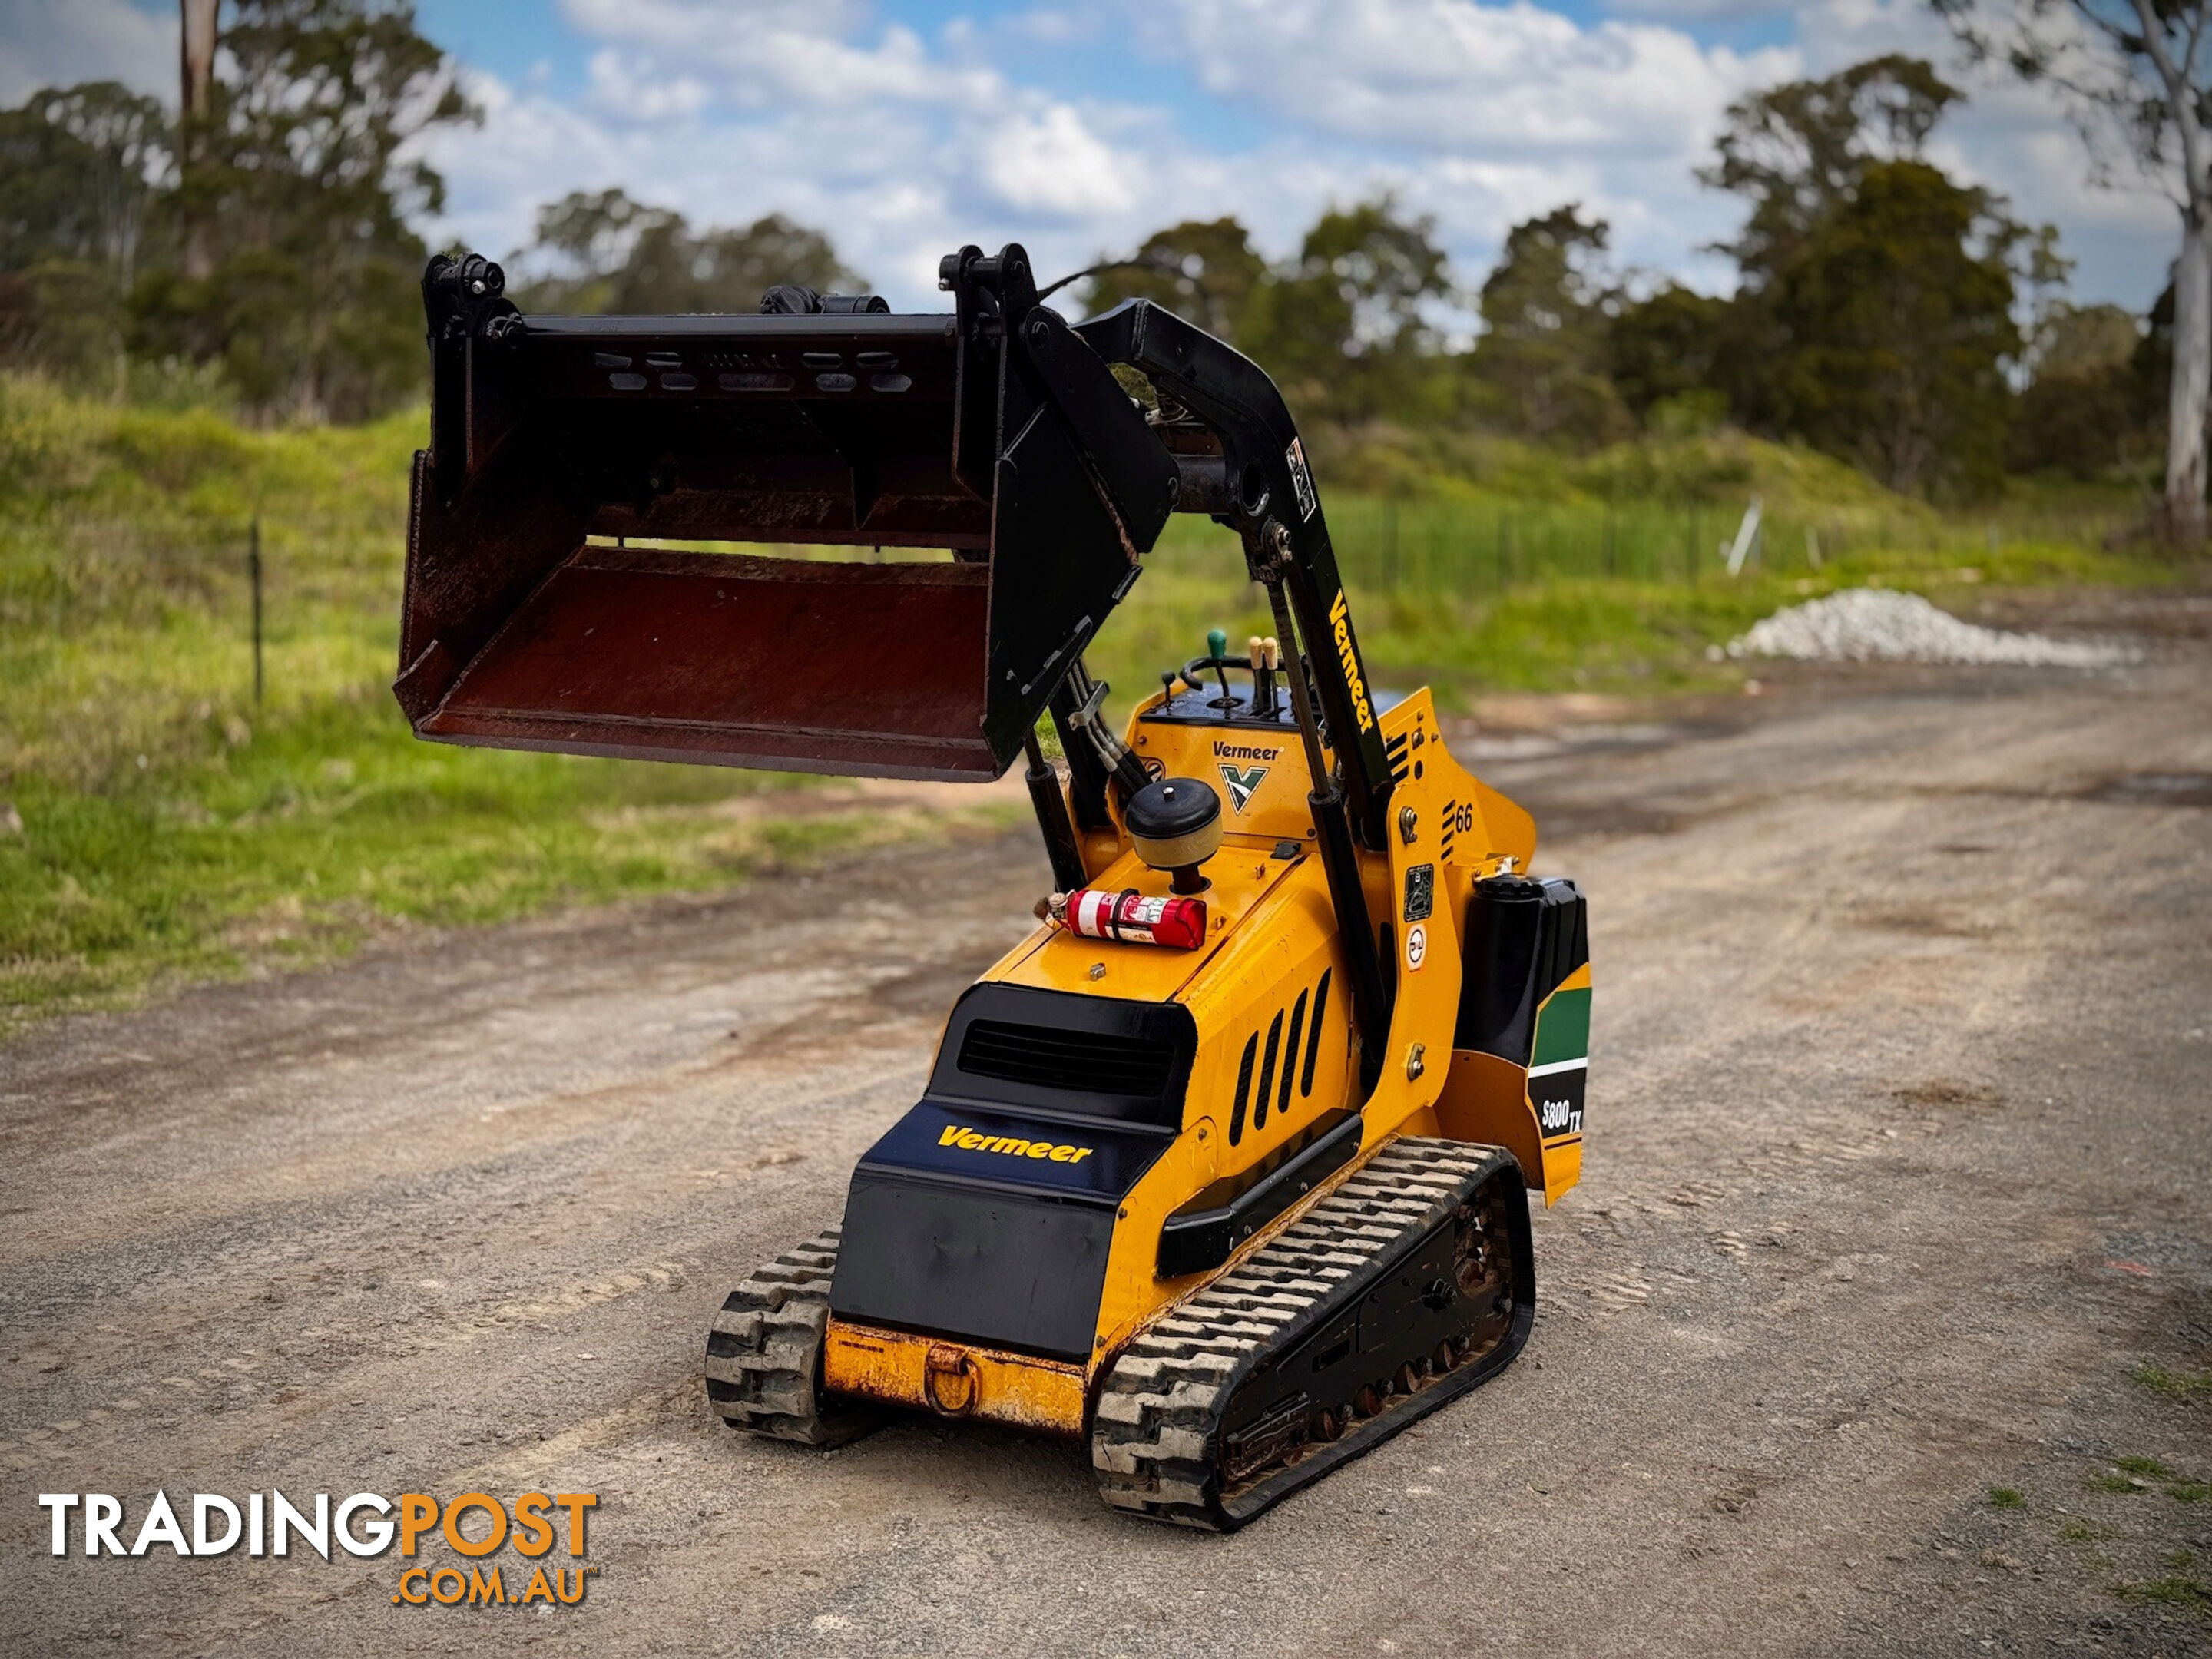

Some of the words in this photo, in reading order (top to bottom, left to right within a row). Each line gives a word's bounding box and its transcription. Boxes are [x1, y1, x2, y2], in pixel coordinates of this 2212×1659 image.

[1329, 588, 1373, 735] Vermeer
[1214, 741, 1279, 760] Vermeer
[1456, 803, 1472, 833] 66
[1542, 1099, 1570, 1129] S800
[938, 1125, 1094, 1163] Vermeer
